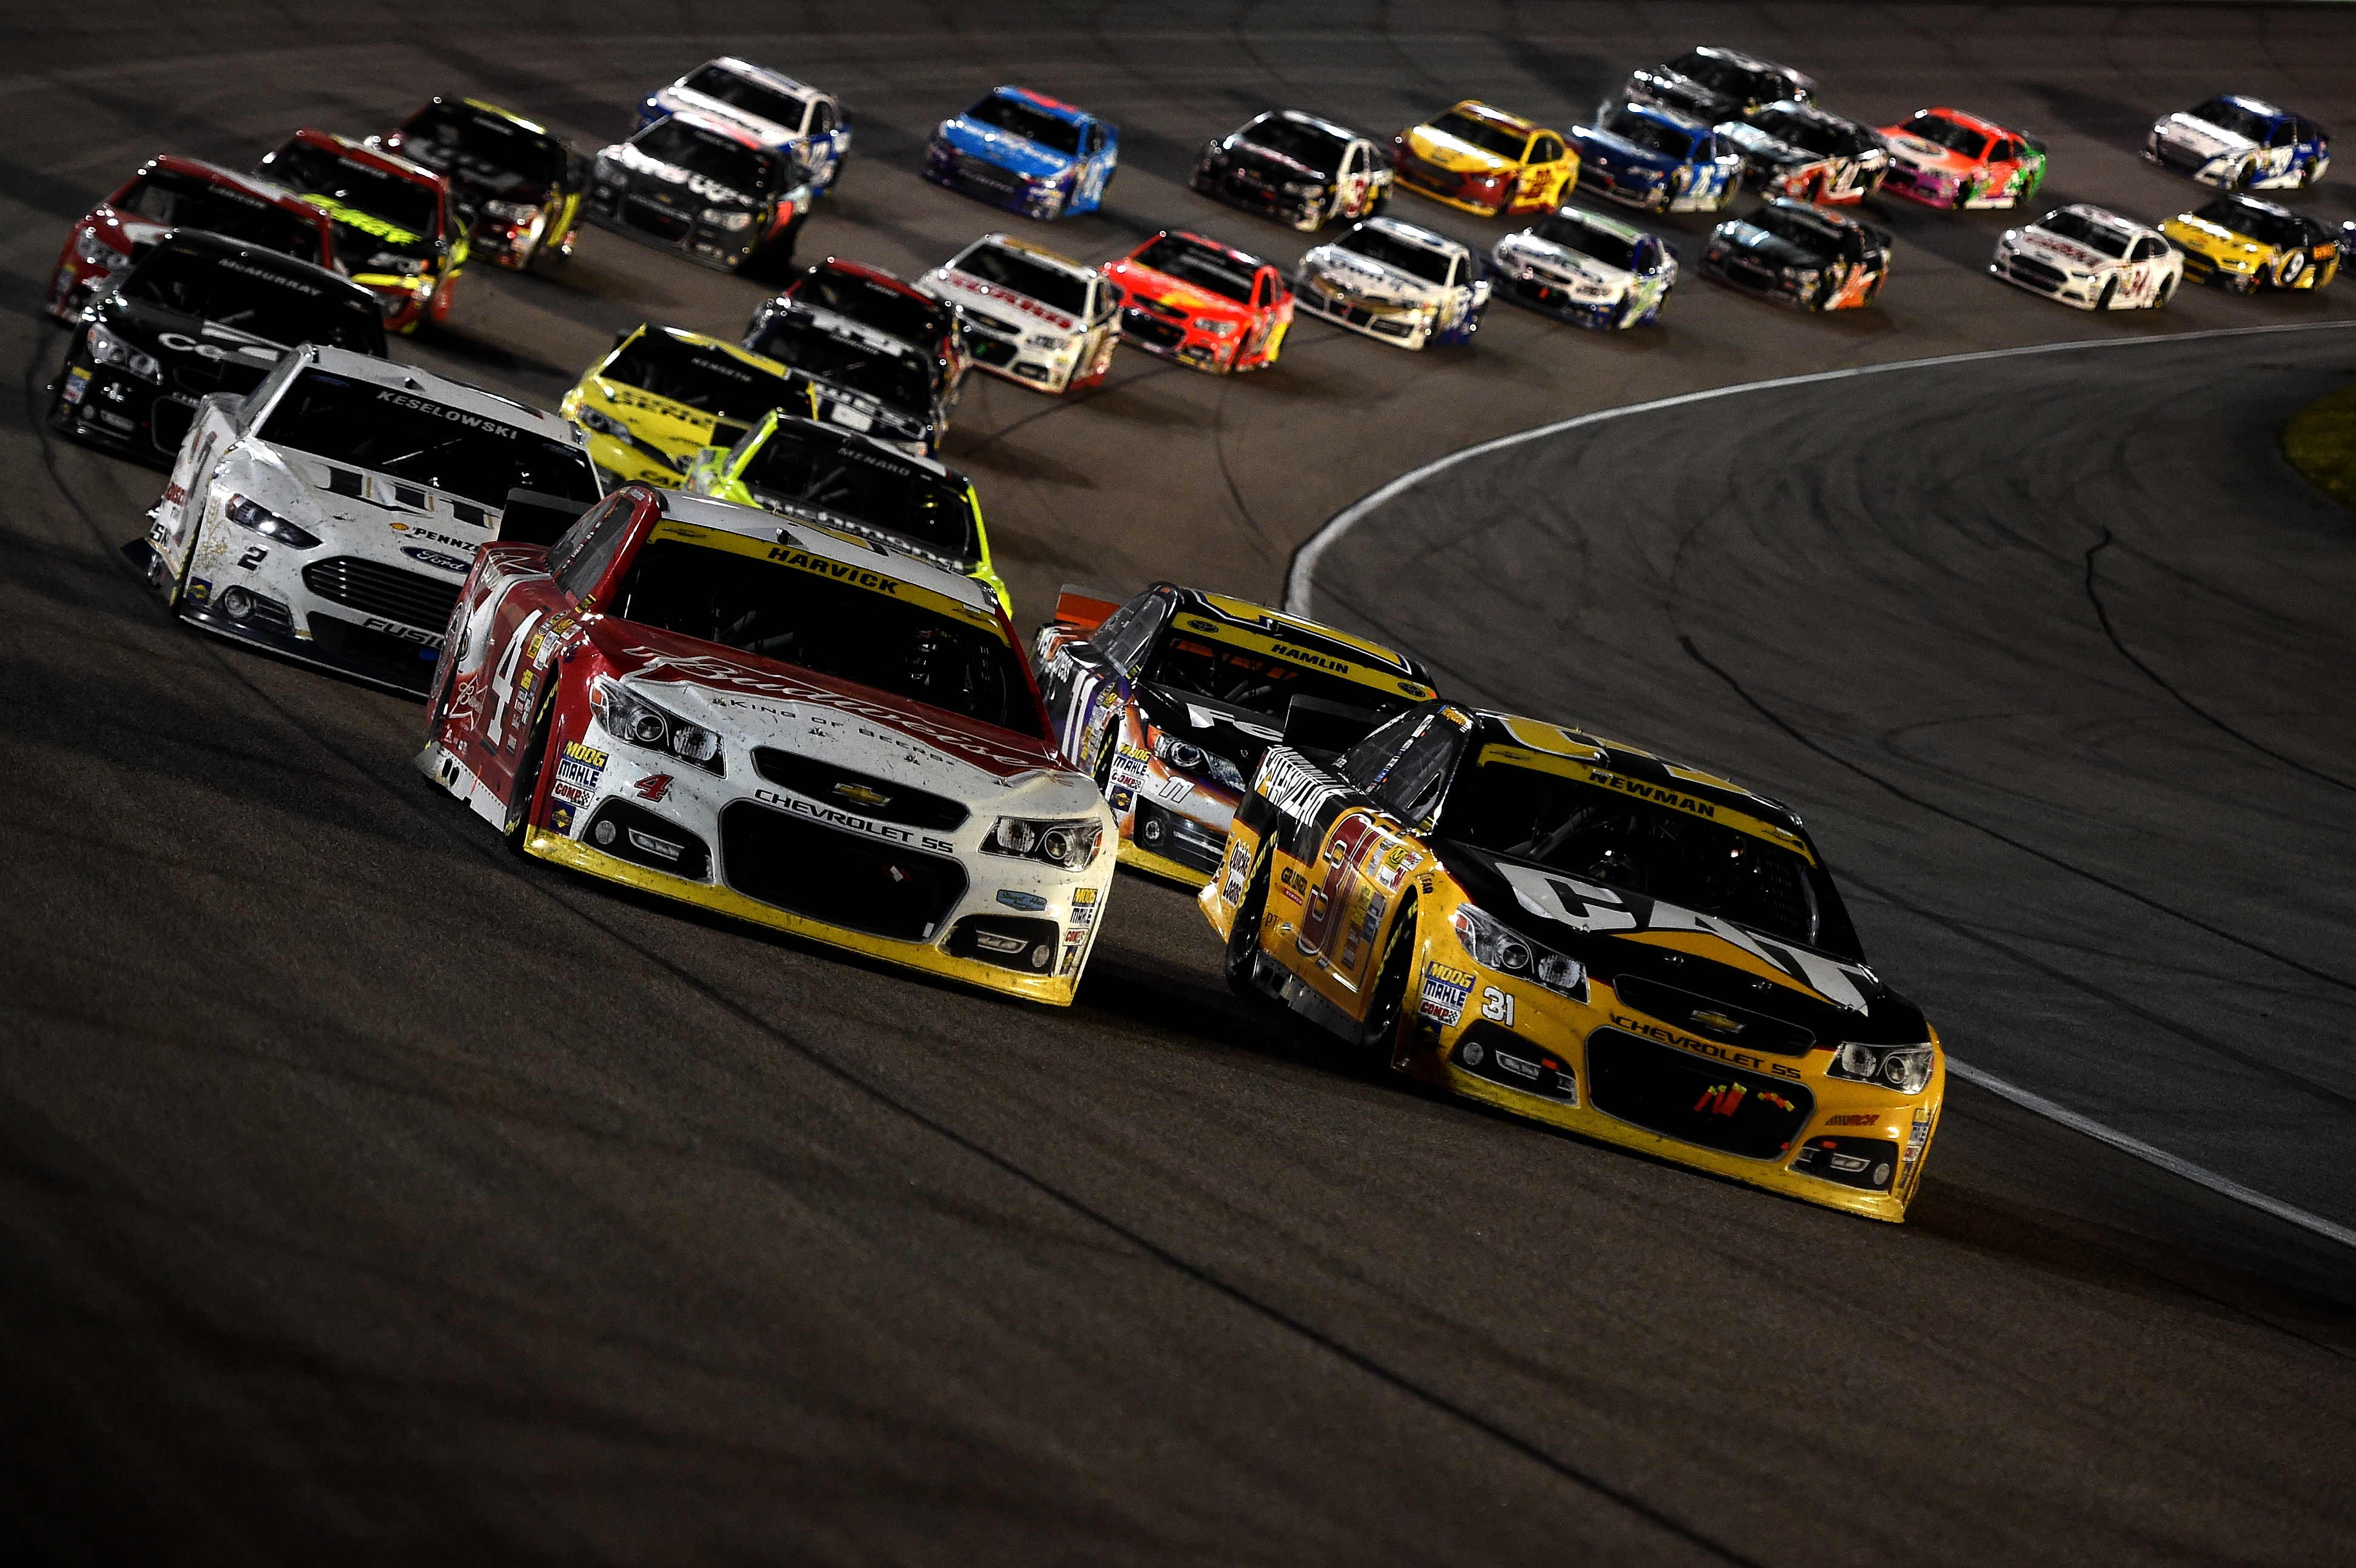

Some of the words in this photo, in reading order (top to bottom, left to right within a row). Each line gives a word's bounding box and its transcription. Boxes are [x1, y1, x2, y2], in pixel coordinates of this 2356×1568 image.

[377, 391, 519, 440] KESELOWSKI
[237, 544, 269, 571] 2
[416, 548, 465, 571] Ford
[767, 547, 900, 595] HARVICK
[1271, 643, 1349, 675] HAMLIN
[487, 609, 544, 746] 4
[729, 699, 797, 720] KING
[811, 716, 845, 728] OF
[563, 740, 608, 768] MOOG
[1113, 756, 1148, 777] MAHLE
[558, 760, 600, 788] MAHLE
[634, 773, 675, 803] 4
[1111, 772, 1136, 786] COMP
[554, 782, 583, 800] COMP
[1158, 775, 1196, 804] 11
[1589, 772, 1716, 818] NEWMAN
[754, 788, 913, 843] CHEVROLET
[921, 836, 954, 854] SS
[1429, 963, 1474, 989] MOOG
[1422, 980, 1467, 1008] MAHLE
[1482, 985, 1515, 1028] 31
[1420, 1002, 1449, 1017] COMP
[1614, 1015, 1764, 1069] CHEVROLET
[1771, 1063, 1802, 1080] SS
